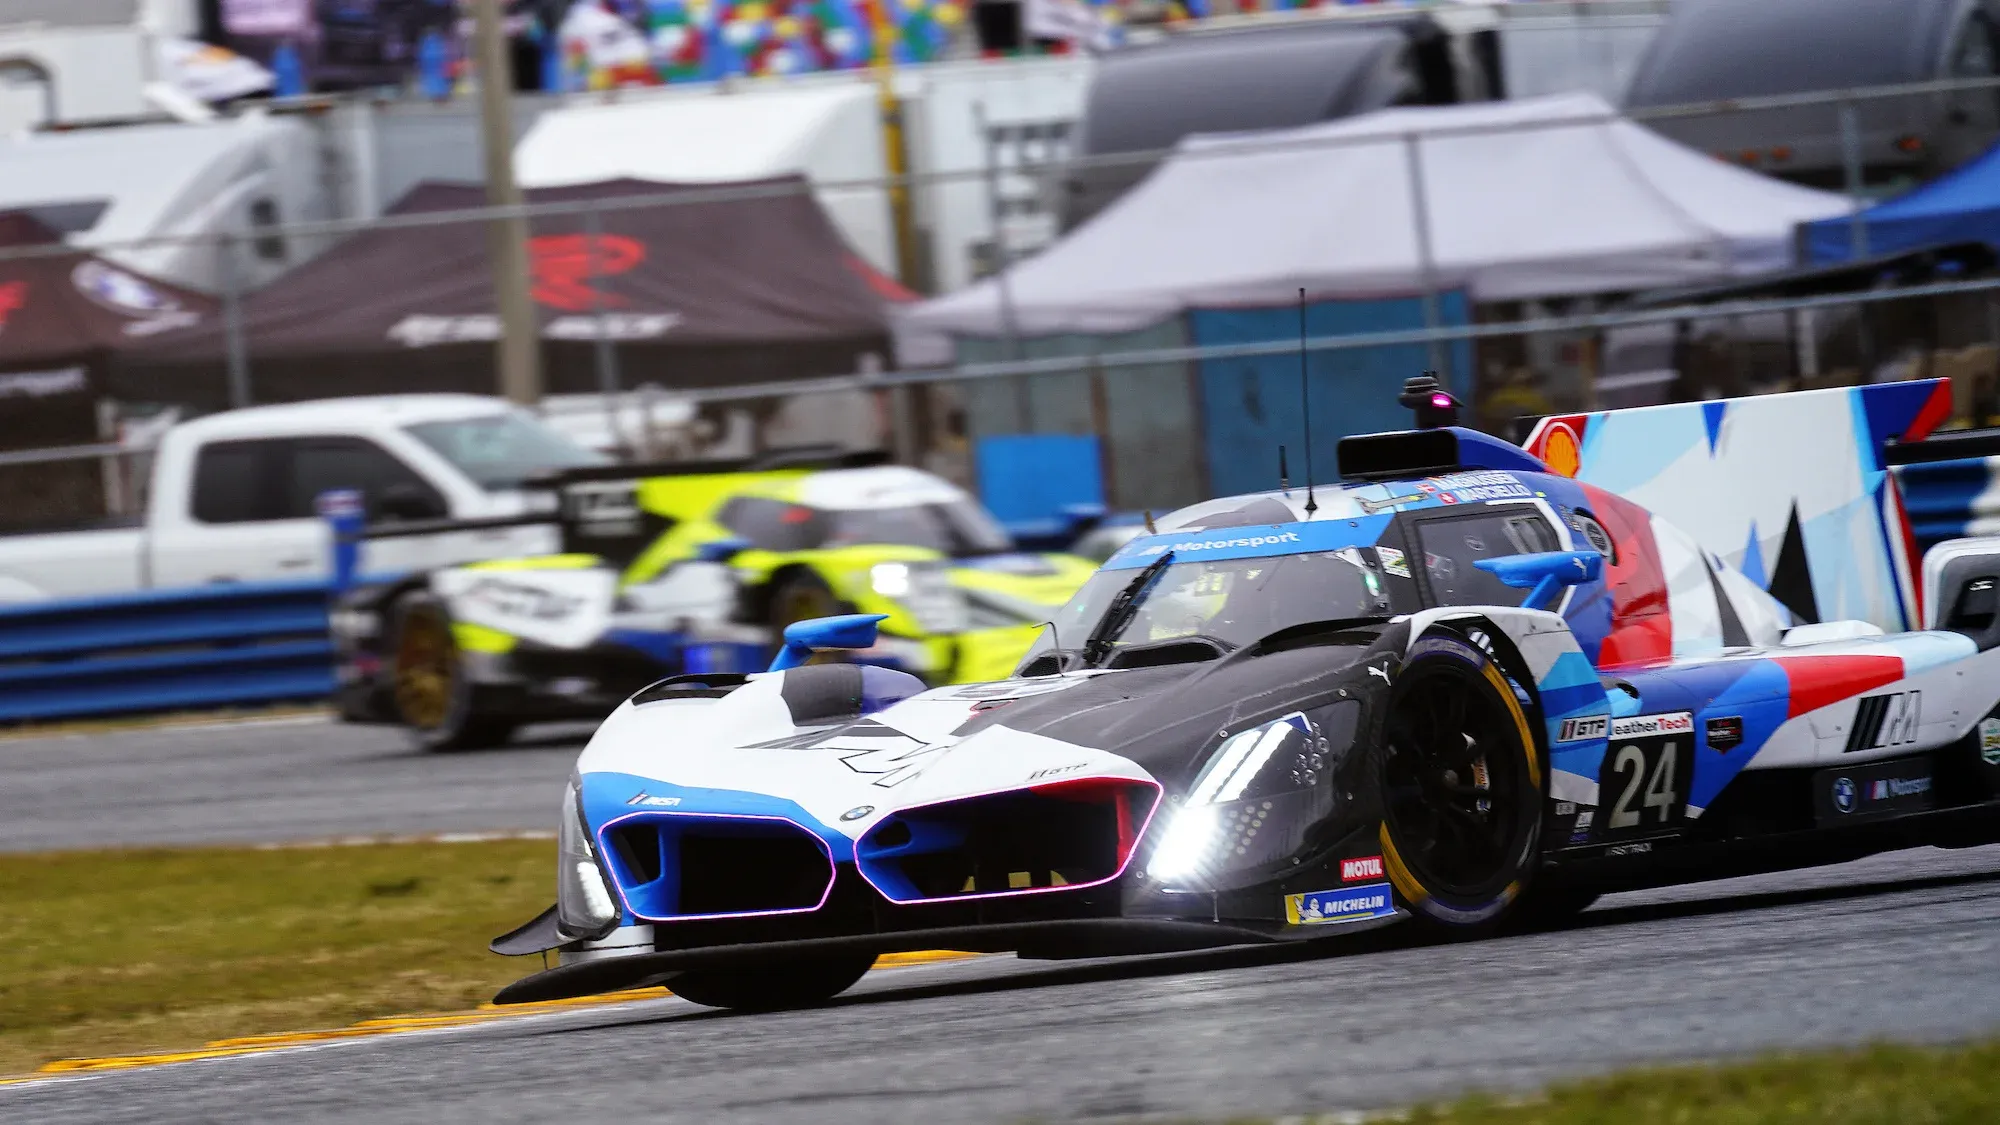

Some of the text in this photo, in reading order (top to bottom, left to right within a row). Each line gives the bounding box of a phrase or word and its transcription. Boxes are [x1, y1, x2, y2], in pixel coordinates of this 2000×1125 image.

[1453, 484, 1533, 502] MARCIELLO
[1172, 531, 1300, 551] Motorsport
[1577, 719, 1606, 736] GTP
[1612, 716, 1690, 735] eatherTech
[1608, 742, 1678, 829] 24
[1343, 859, 1383, 878] MOTUL
[1324, 896, 1385, 914] MICHELIN
